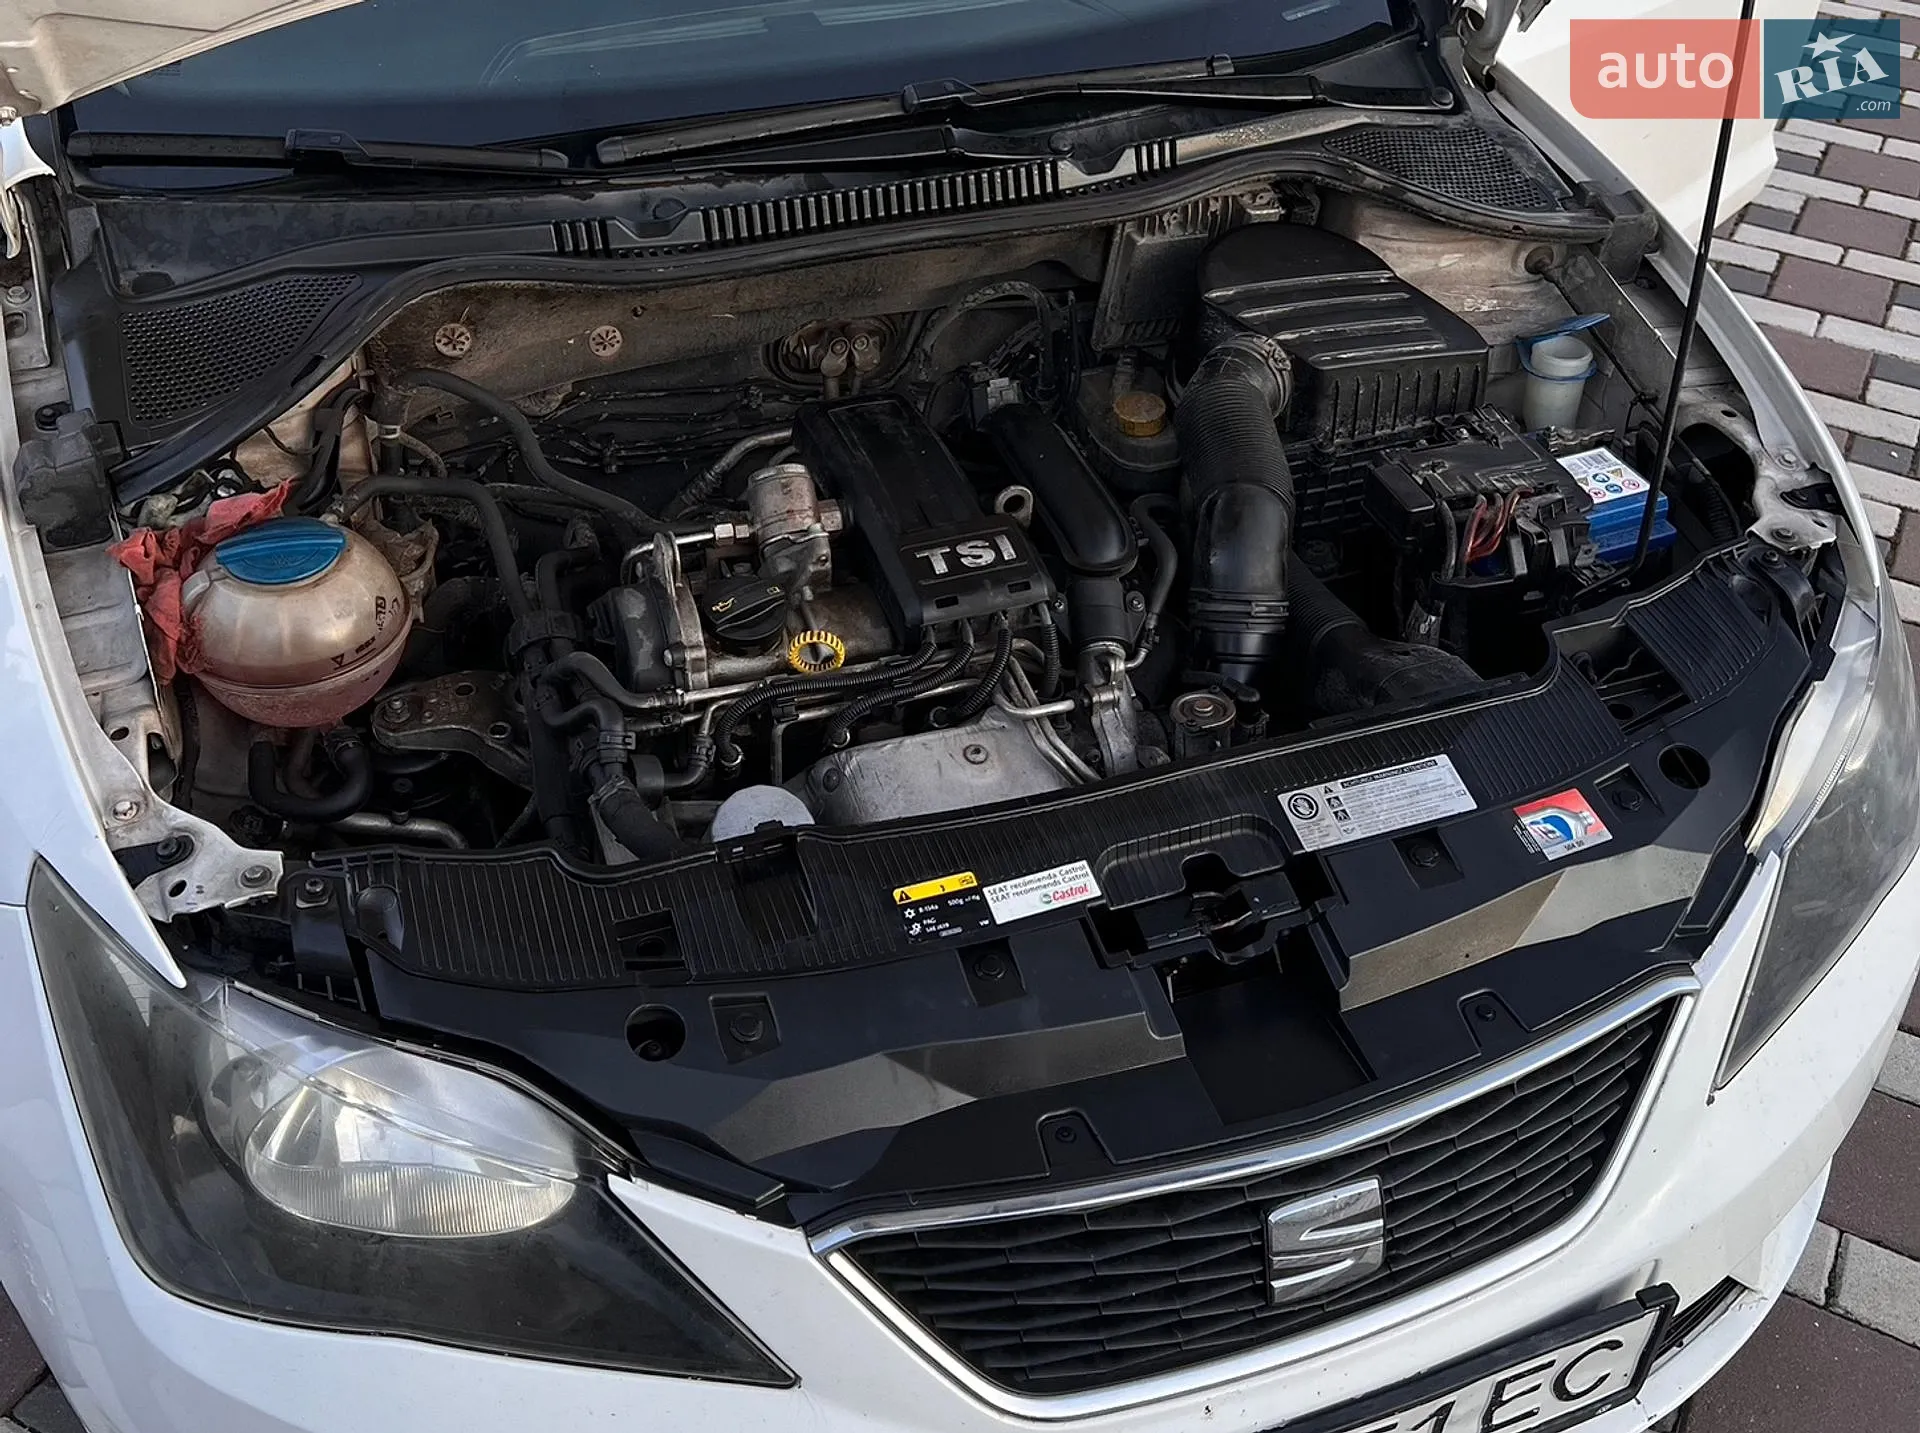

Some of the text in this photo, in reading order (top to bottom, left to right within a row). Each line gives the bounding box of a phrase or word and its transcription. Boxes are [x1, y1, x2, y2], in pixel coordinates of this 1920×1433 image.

[914, 534, 1017, 575] TSI
[1059, 864, 1087, 876] Castrol
[1062, 872, 1089, 884] Castrol
[1053, 884, 1089, 901] Castrol
[1360, 1339, 1624, 1433] 1 EC
